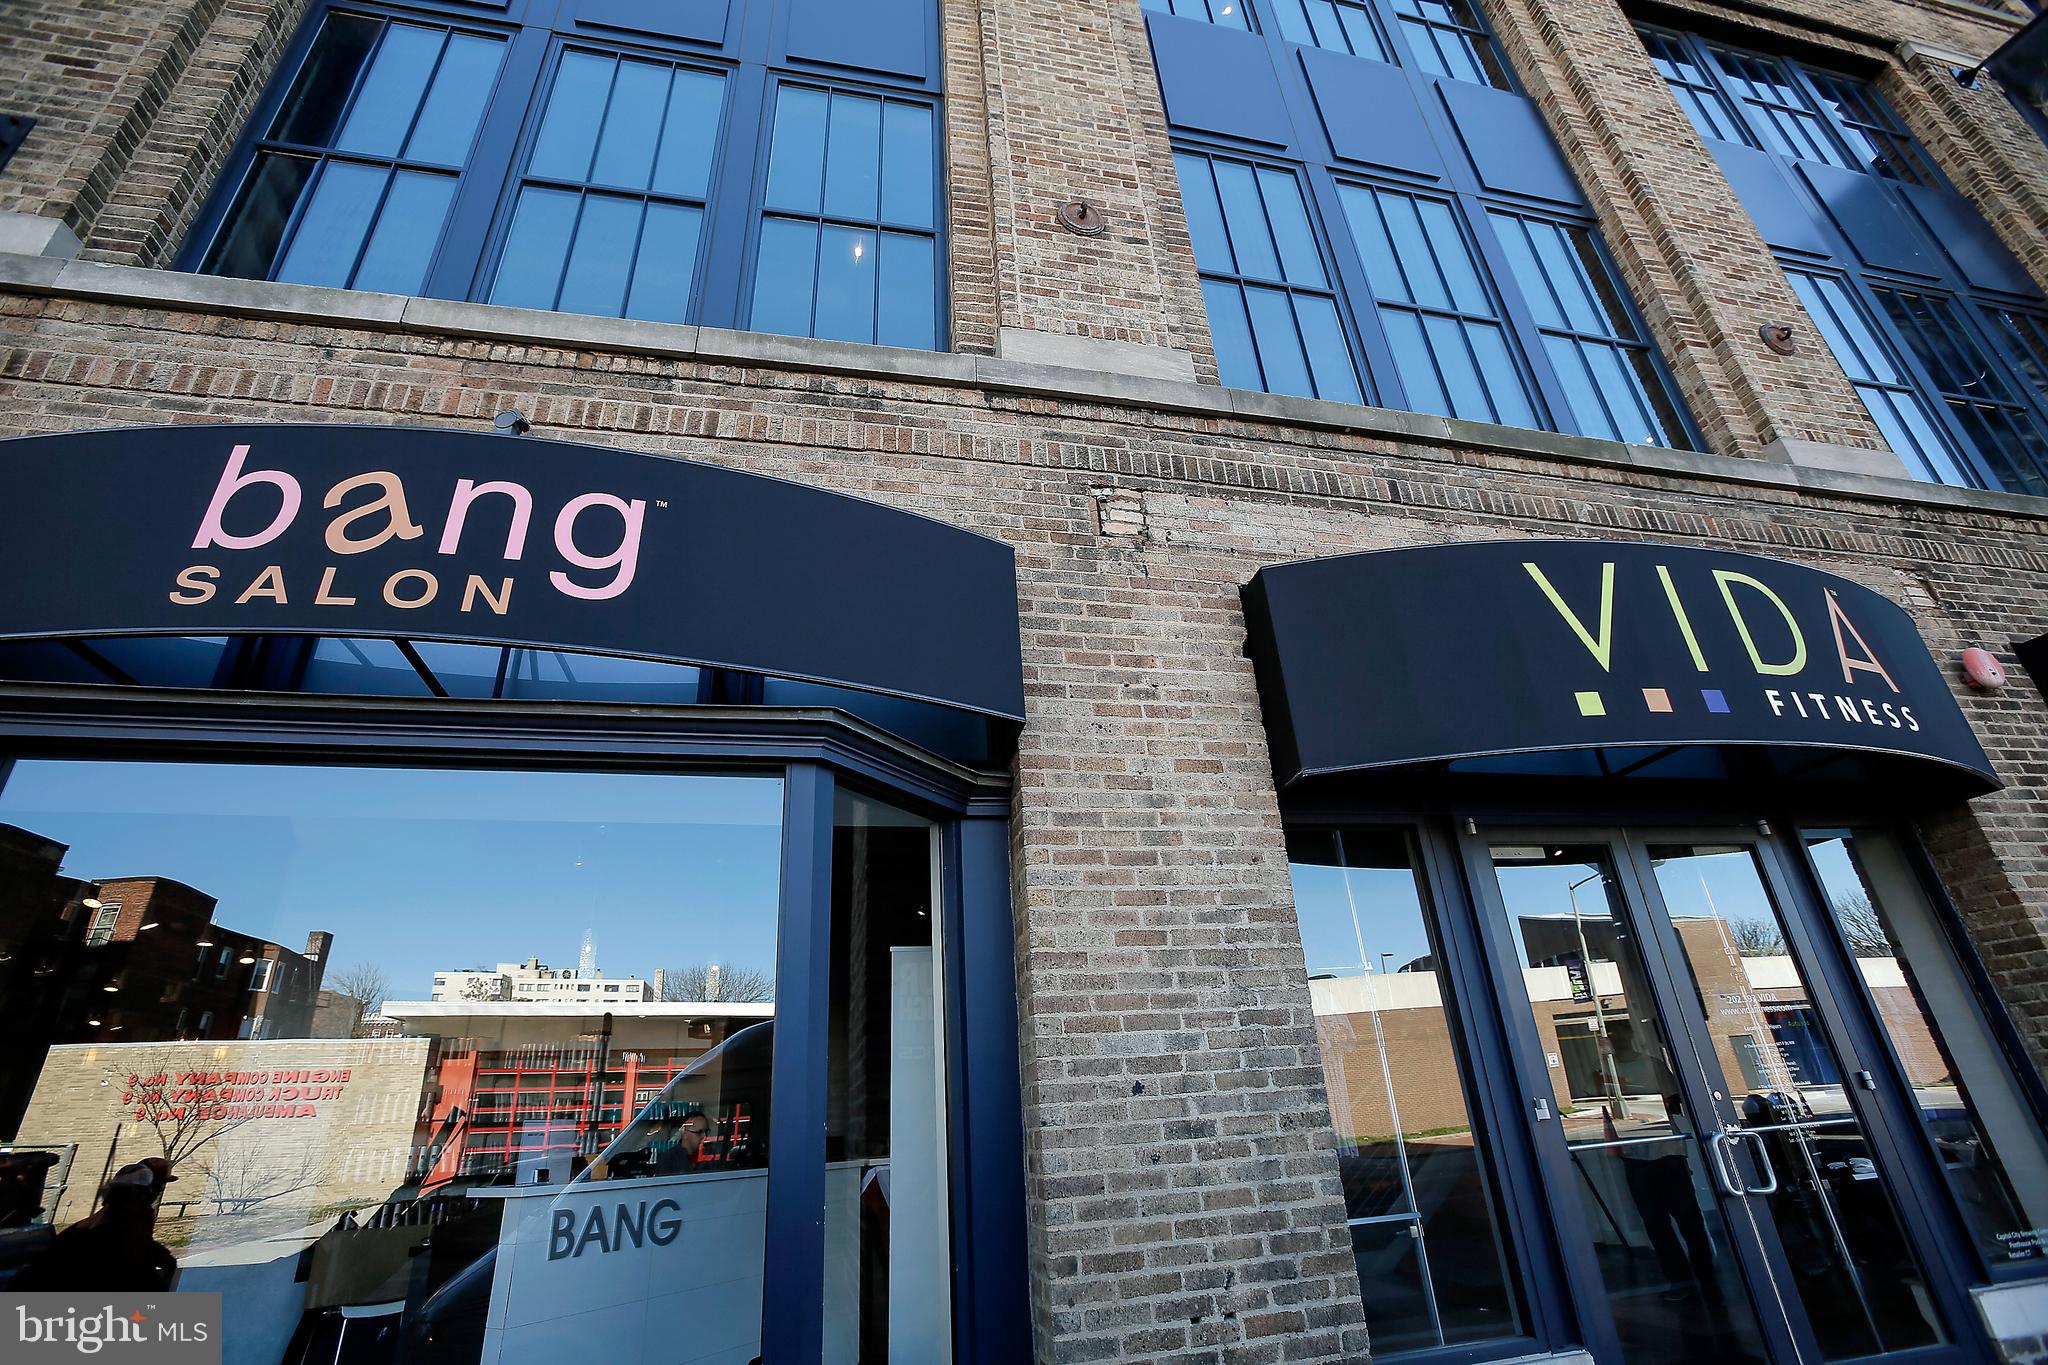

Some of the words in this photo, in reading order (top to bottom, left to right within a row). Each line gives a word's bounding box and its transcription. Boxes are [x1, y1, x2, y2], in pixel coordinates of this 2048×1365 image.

[191, 445, 647, 600] bang
[169, 565, 514, 615] SALON
[1522, 562, 1900, 693] VIDA
[1765, 689, 1920, 732] FITNESS
[546, 1199, 683, 1262] BANG
